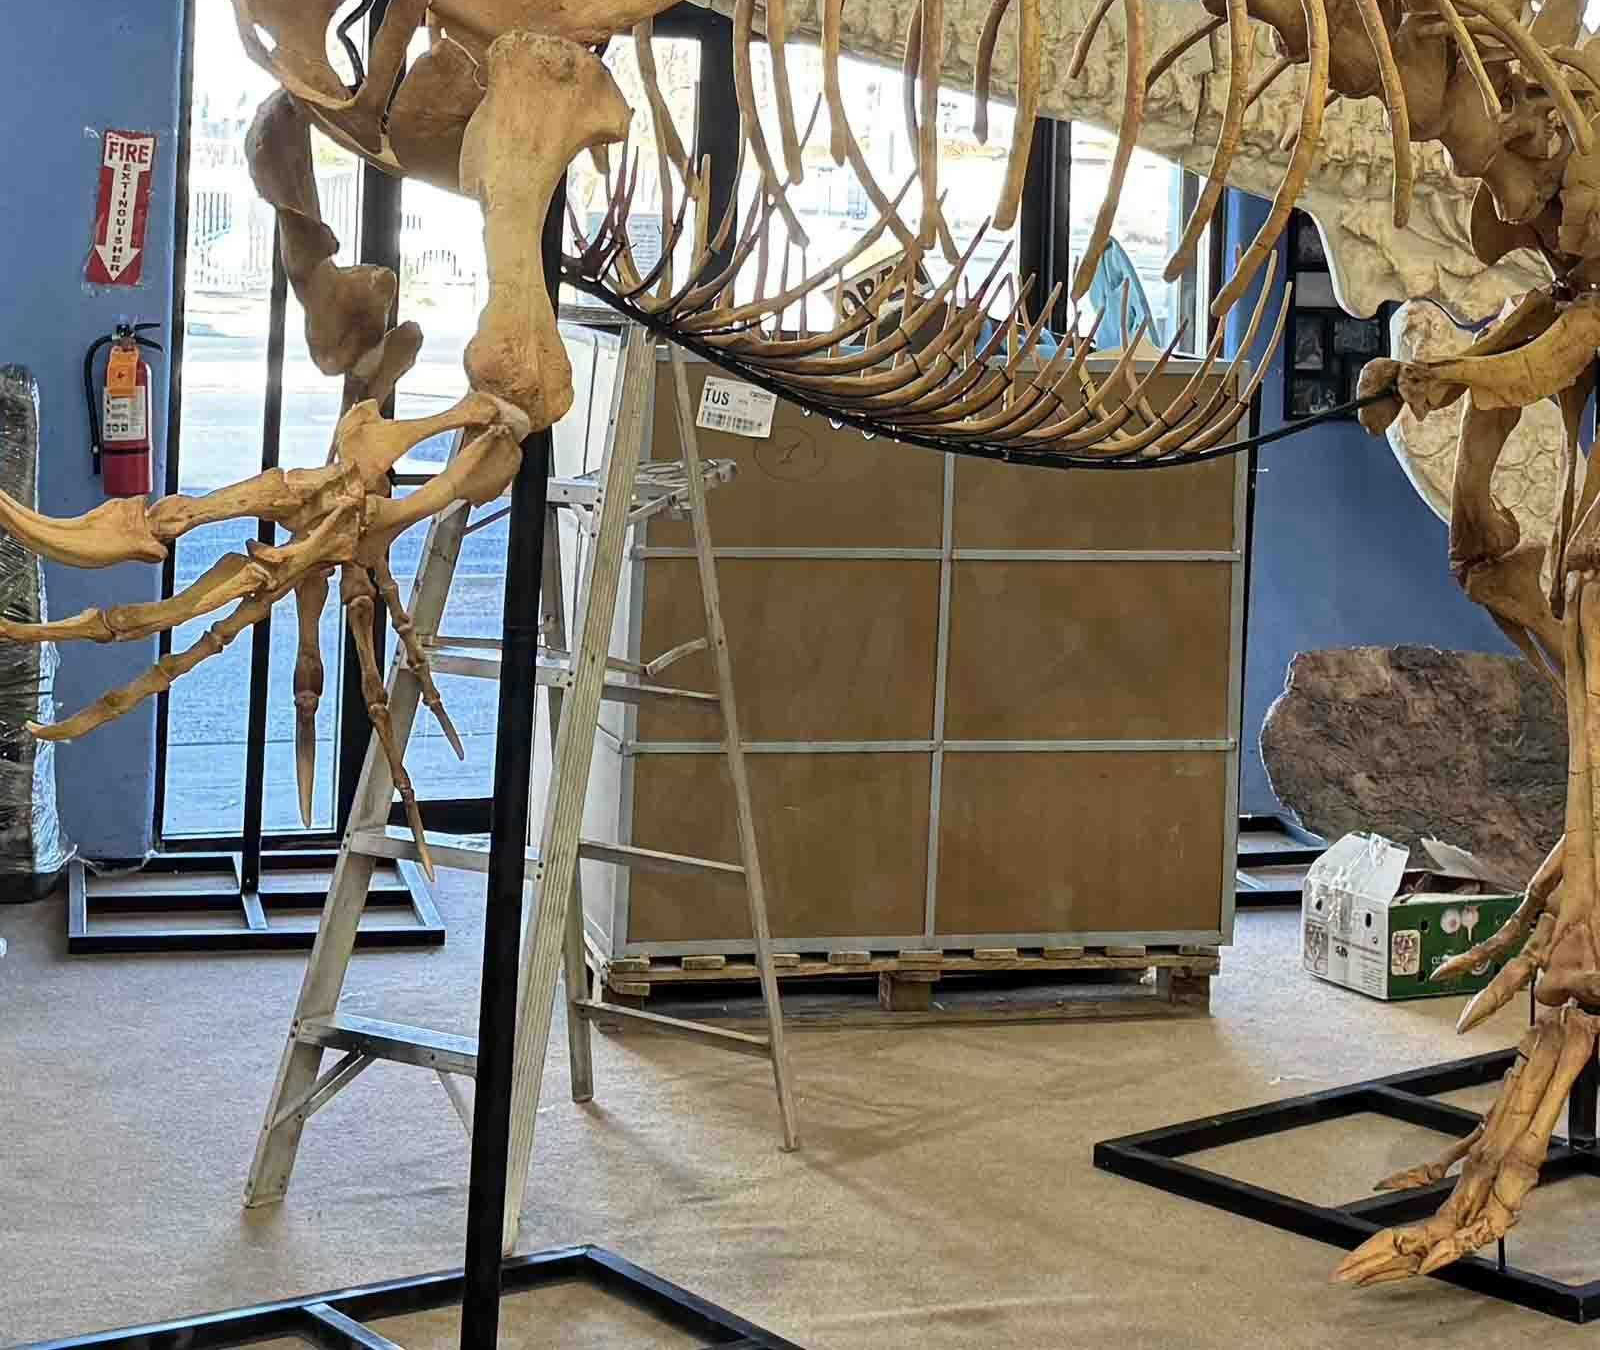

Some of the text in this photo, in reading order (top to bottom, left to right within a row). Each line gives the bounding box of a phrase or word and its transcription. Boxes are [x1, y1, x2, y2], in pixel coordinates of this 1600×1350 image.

[108, 141, 149, 164] FIRE
[110, 163, 131, 272] EXTINGUISHER
[704, 388, 730, 406] TUS
